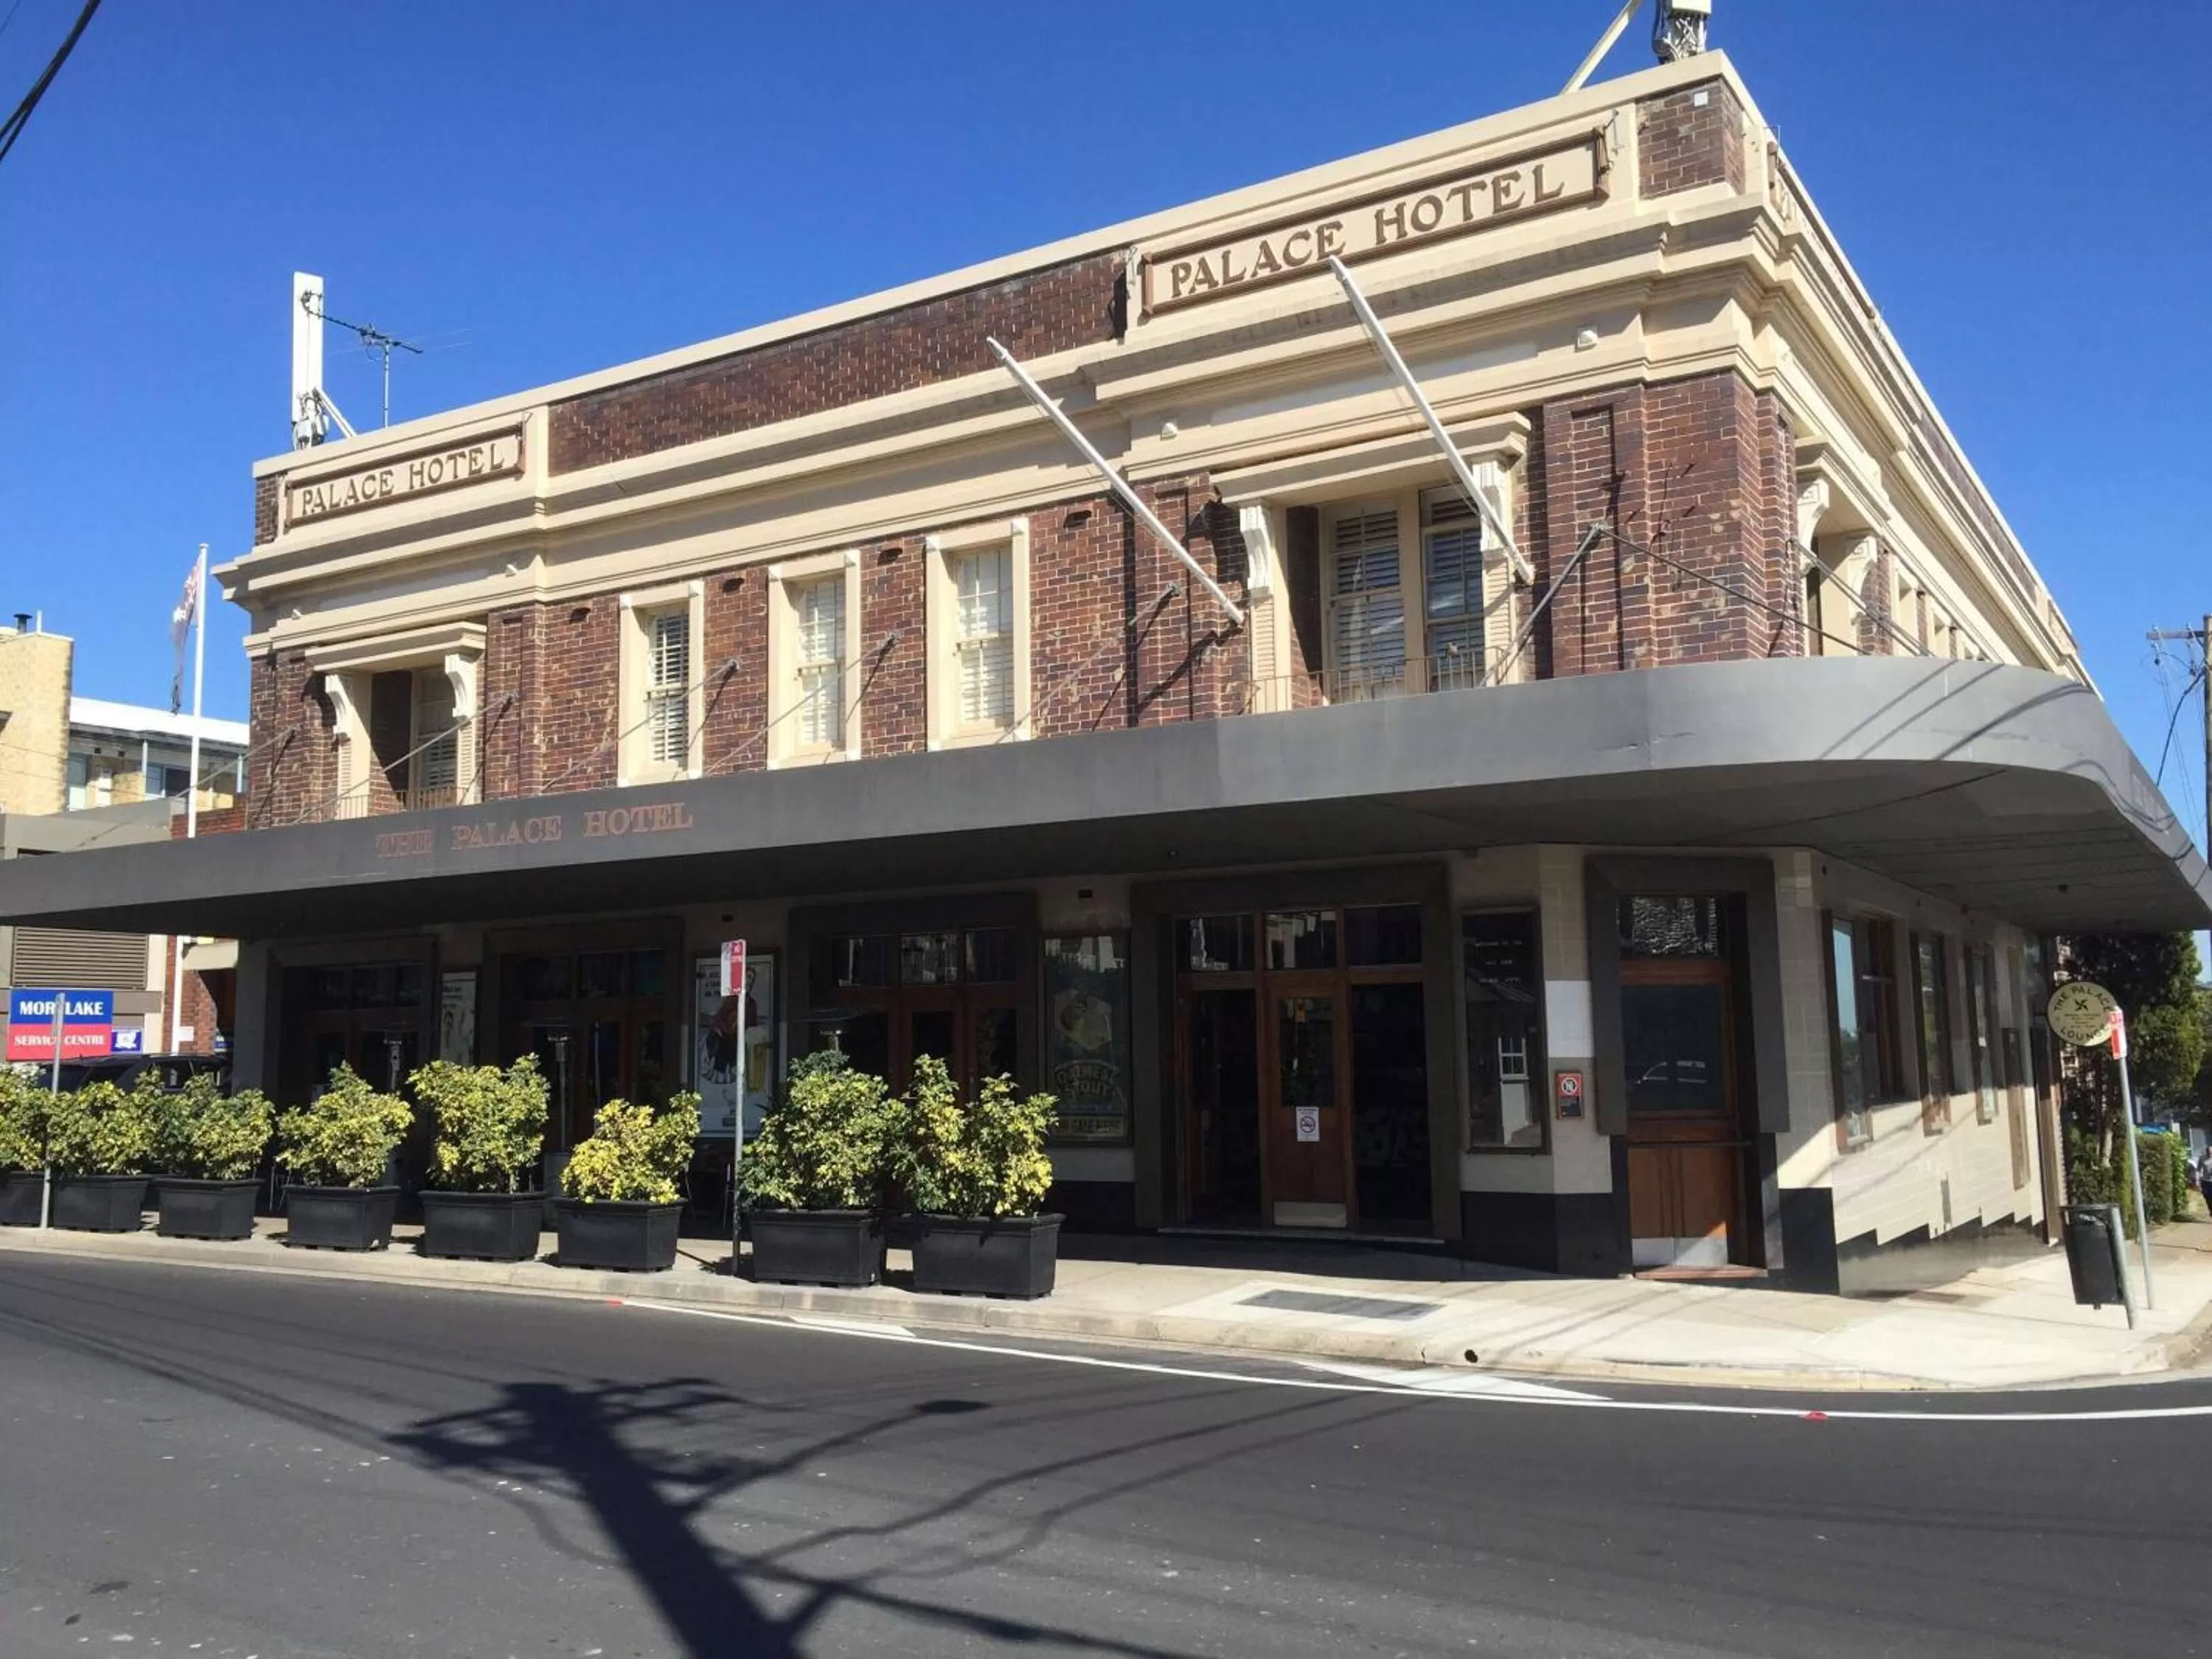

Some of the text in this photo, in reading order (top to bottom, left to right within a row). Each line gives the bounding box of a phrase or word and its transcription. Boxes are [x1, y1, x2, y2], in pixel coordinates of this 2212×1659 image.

[1170, 164, 1565, 298] PALACE HOTEL
[302, 443, 505, 515] PALACE HOTEL
[375, 802, 694, 858] THE PALACE HOTEL
[20, 1001, 104, 1015] MORLAKE
[64, 1034, 105, 1046] CENTRE
